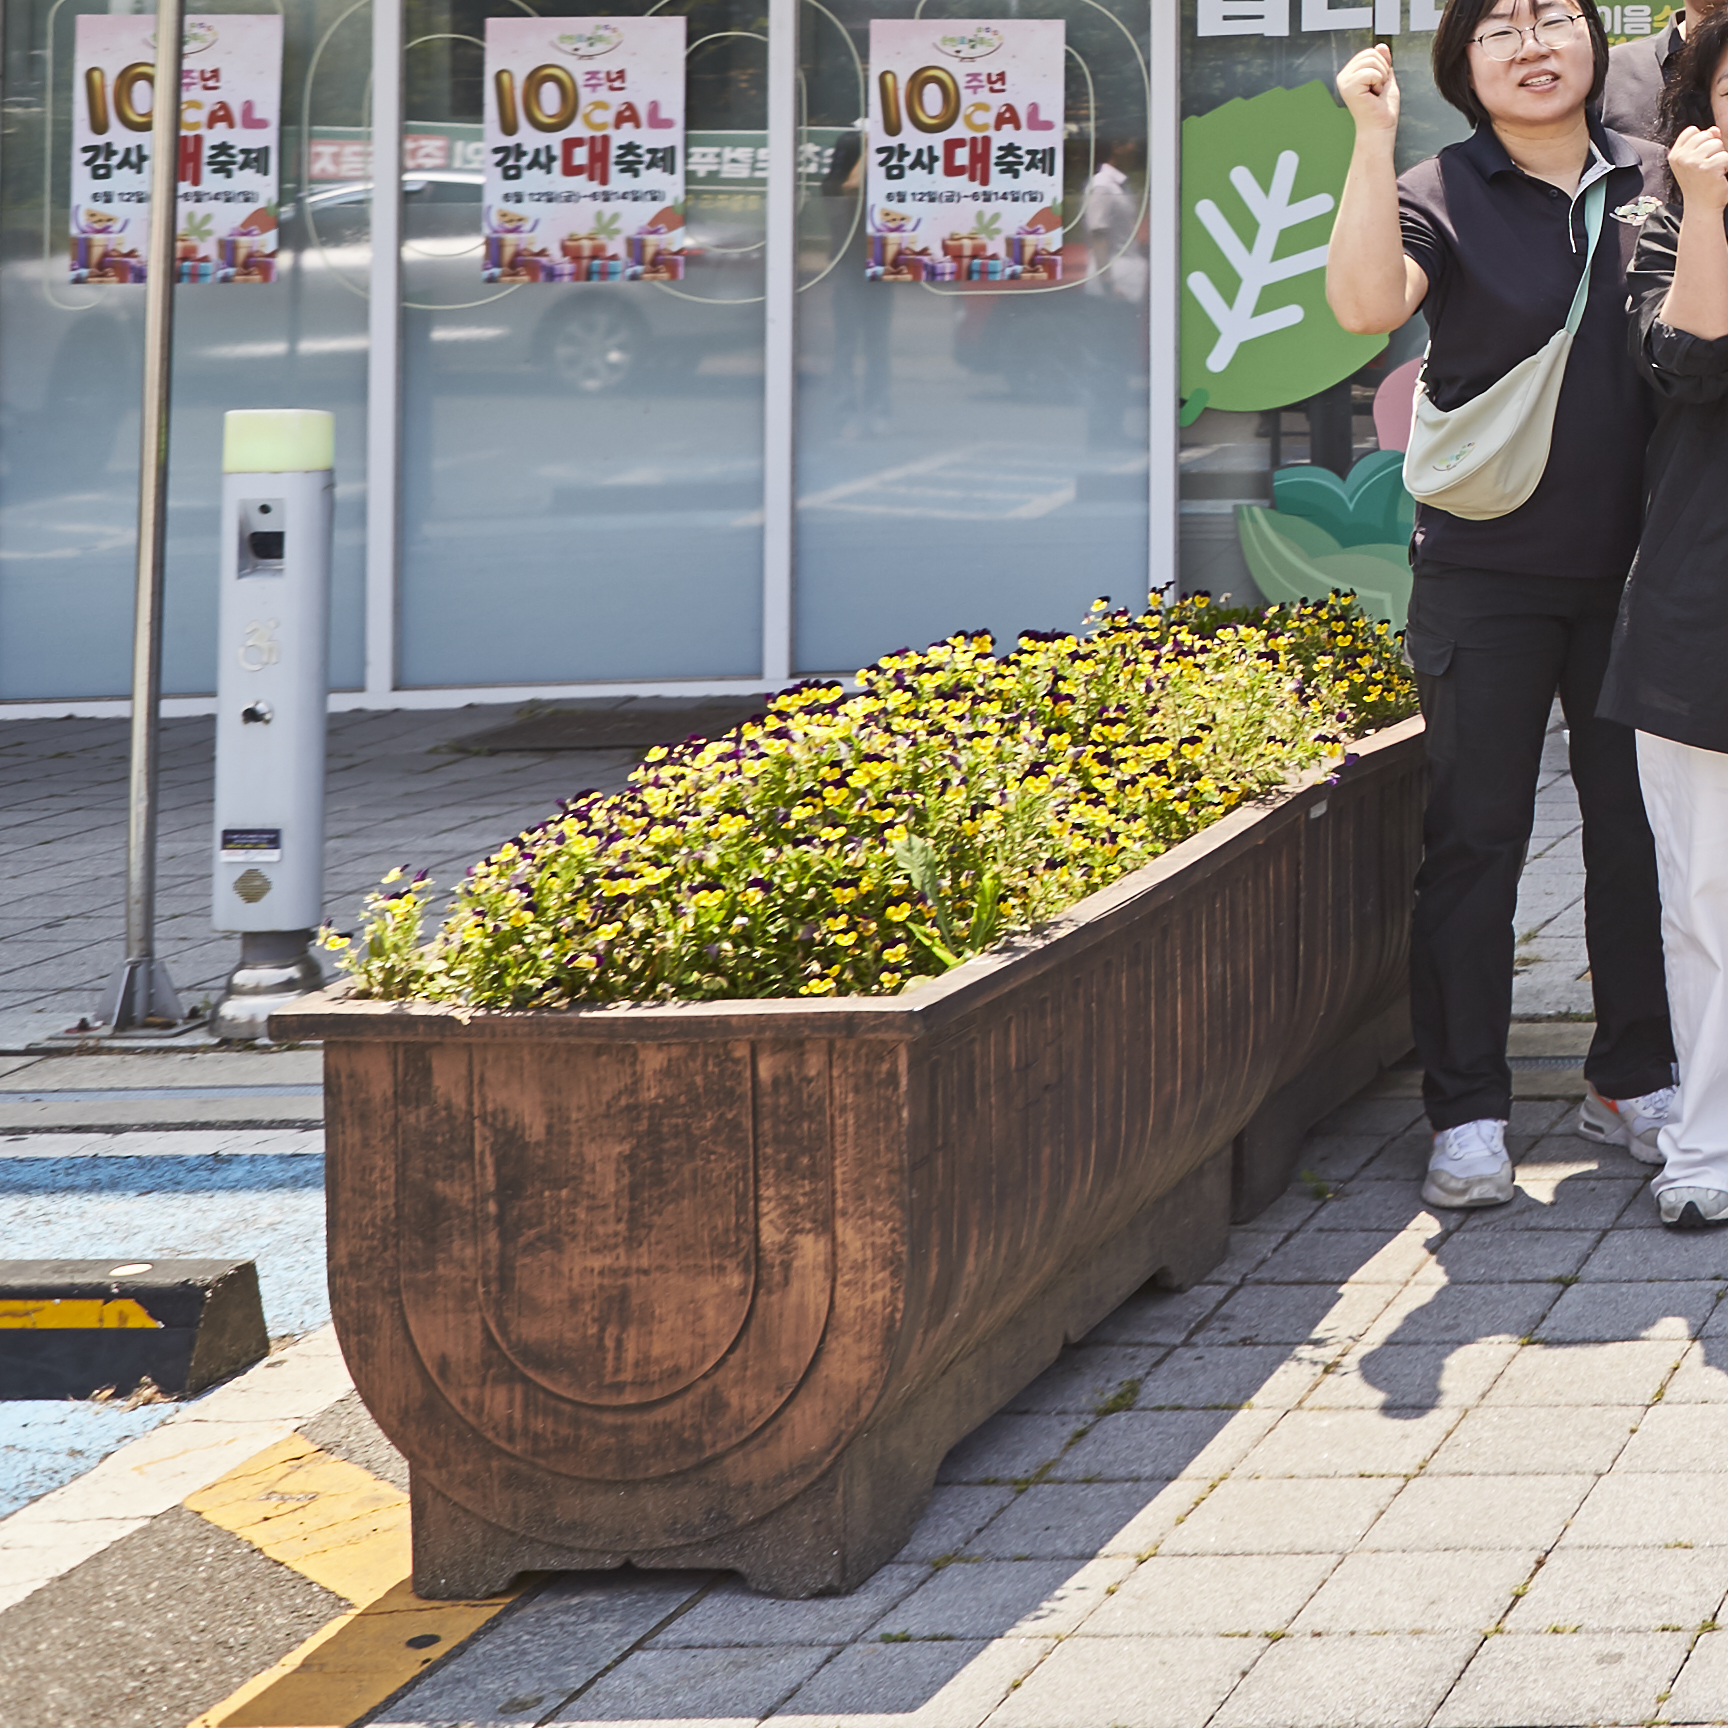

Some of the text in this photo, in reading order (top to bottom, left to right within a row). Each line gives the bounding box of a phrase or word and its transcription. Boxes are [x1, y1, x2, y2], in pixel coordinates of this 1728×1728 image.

[494, 63, 579, 137] 10
[582, 68, 627, 93] 주년
[878, 64, 961, 137] 10
[963, 71, 1007, 95] 주년
